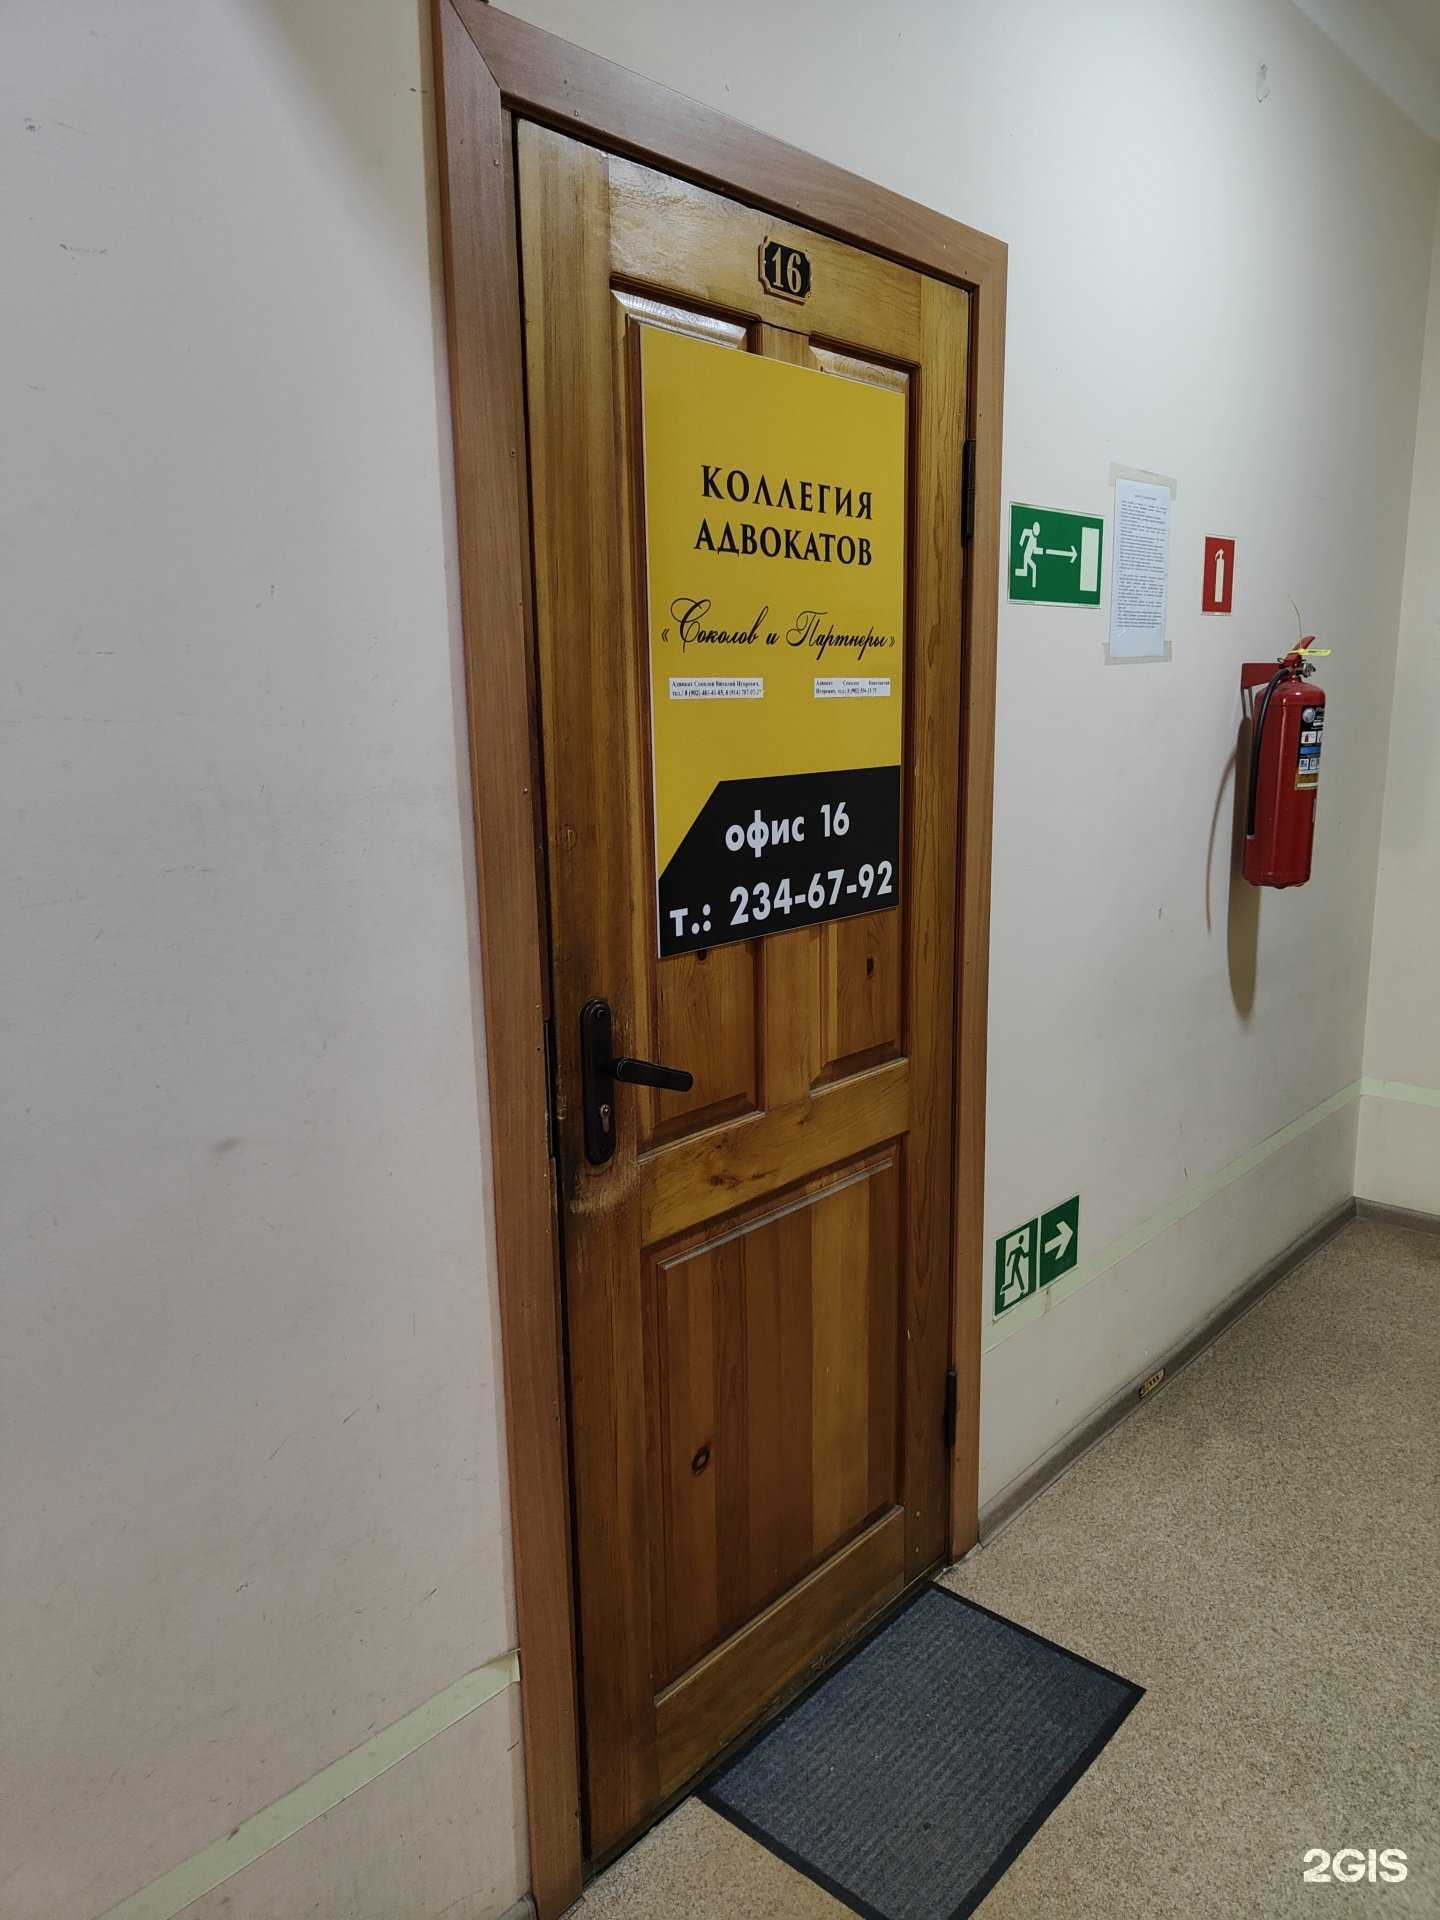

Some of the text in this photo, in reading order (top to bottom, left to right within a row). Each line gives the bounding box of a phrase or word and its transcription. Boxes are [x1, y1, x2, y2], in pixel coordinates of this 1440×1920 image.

[772, 247, 802, 293] 16
[701, 464, 872, 520] КОЛЛЕГИЯ
[694, 518, 872, 566] АДВОКАТОВ
[765, 632, 780, 645] и
[725, 801, 850, 858] офис 16
[729, 860, 893, 926] 234-67-92
